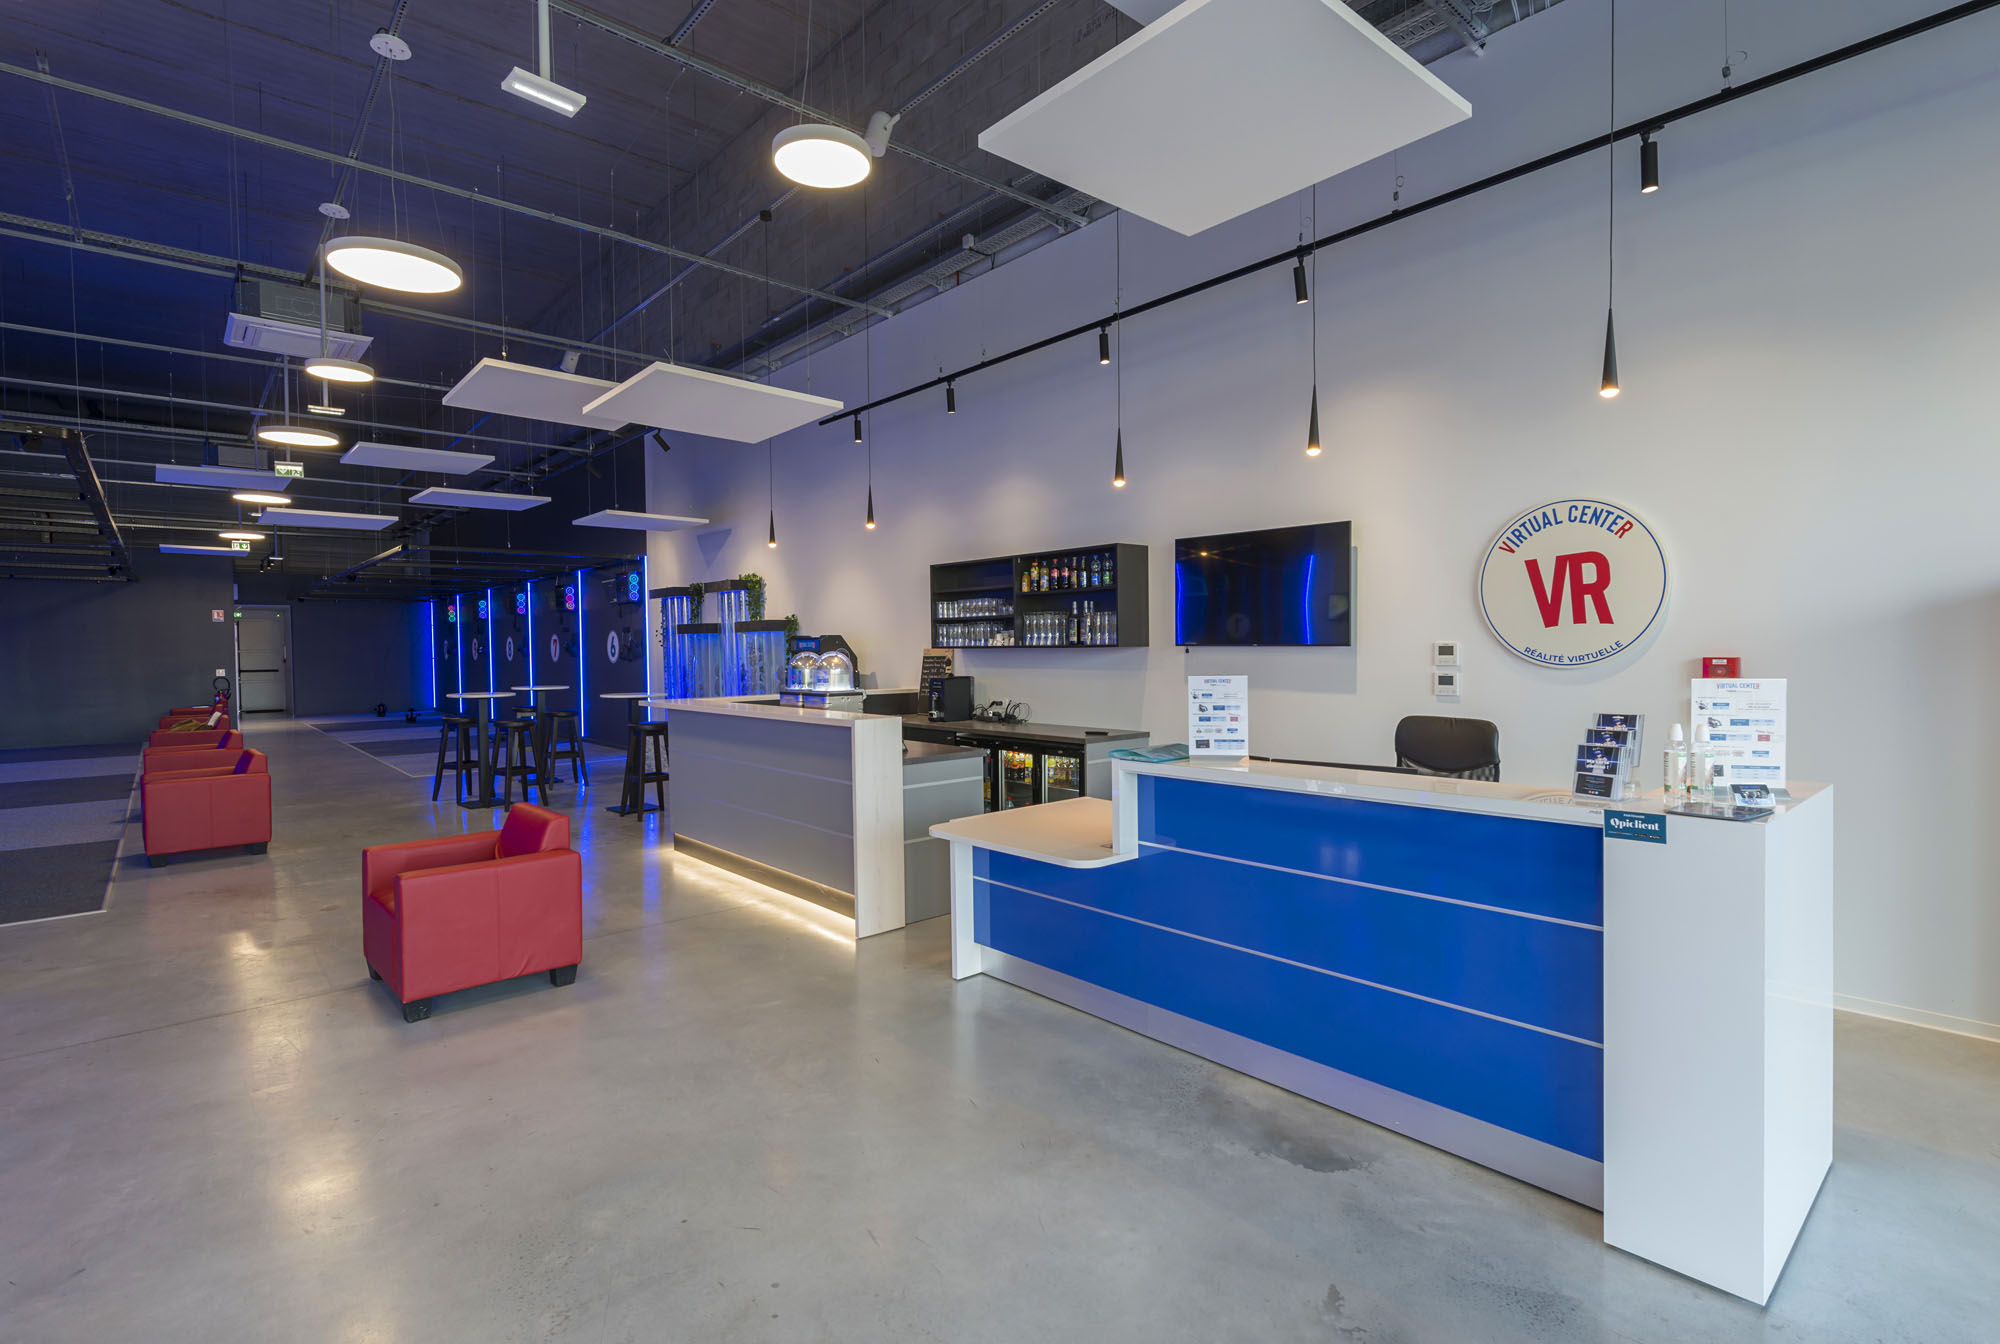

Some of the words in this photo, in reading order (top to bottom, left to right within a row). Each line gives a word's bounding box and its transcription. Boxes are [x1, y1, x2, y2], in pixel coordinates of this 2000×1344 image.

[1498, 508, 1563, 554] VIRTUAL
[1567, 505, 1634, 539] CENTER
[1524, 551, 1614, 628] VR
[1523, 646, 1565, 663] RÉALITÉ
[1567, 640, 1624, 663] VIRTUELLE
[1610, 817, 1660, 831] Qpiclient
